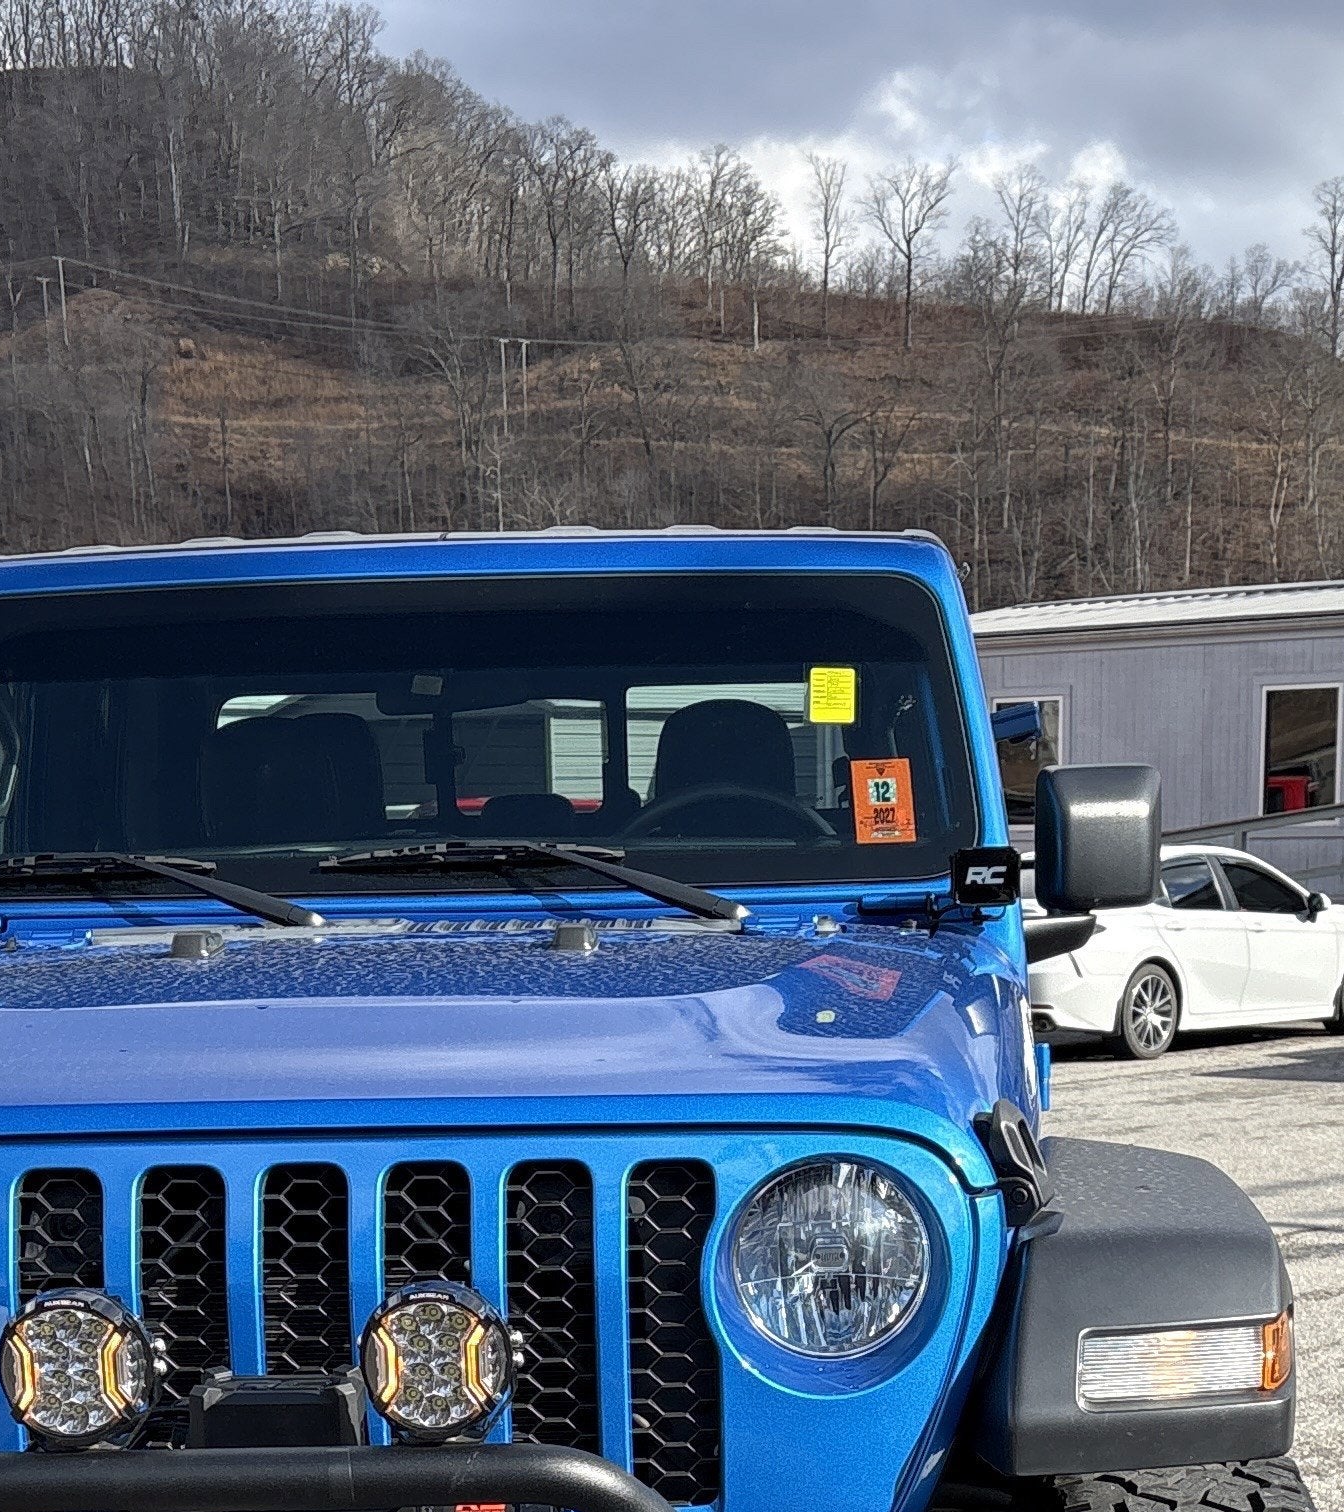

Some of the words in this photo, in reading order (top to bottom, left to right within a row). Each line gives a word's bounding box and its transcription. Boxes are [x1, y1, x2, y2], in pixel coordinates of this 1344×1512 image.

[873, 781, 891, 803] 12
[873, 807, 895, 824] 2027
[965, 865, 1007, 885] RC
